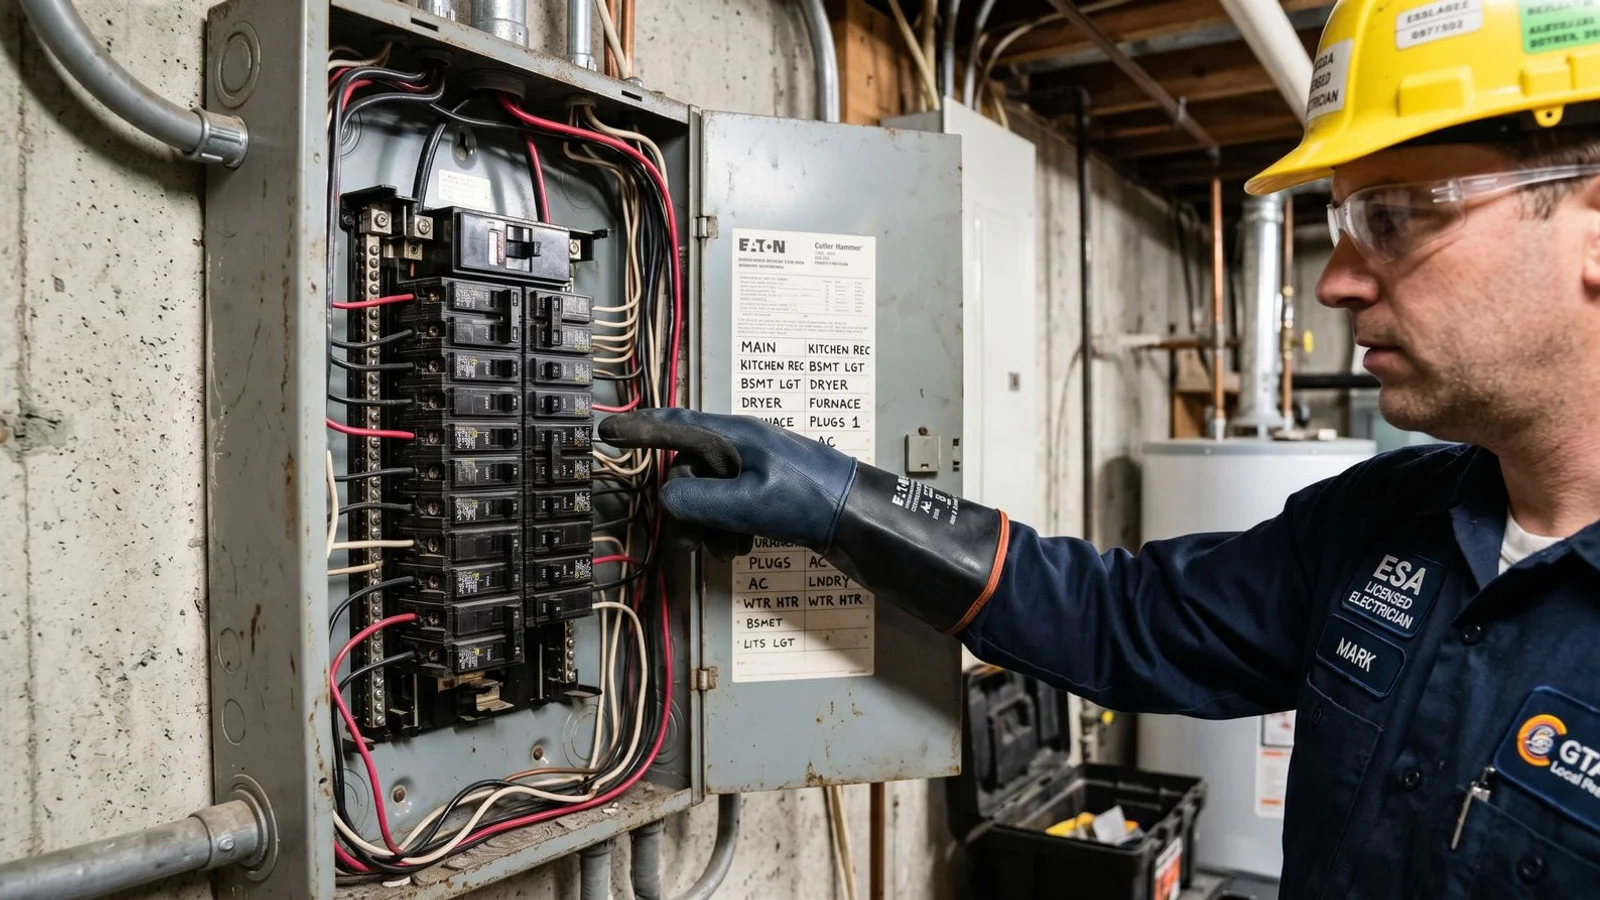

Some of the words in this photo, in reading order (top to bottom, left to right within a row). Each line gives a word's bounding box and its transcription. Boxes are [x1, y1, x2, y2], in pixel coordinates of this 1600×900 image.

[815, 242, 833, 250] Cutler
[836, 243, 861, 251] Hammer
[741, 341, 776, 353] MAIN
[808, 344, 849, 355] KITCHEN
[853, 345, 870, 355] REC
[740, 359, 784, 371] KITCHEN
[788, 360, 805, 371] REC
[809, 361, 839, 372] BSMT
[845, 363, 864, 372] LGT
[741, 378, 774, 389] BSMT
[780, 379, 801, 389] LGT
[810, 379, 848, 390] DRYER
[742, 397, 782, 408] DRYER
[809, 398, 861, 409] FURNACE
[810, 416, 845, 428] PLUGS
[852, 416, 860, 428] 1
[749, 557, 791, 569] PLUGS
[1372, 554, 1426, 596] ESA
[748, 578, 769, 589] AC
[809, 575, 850, 588] LNDRY
[808, 595, 834, 606] WTR
[839, 593, 863, 605] HTR
[1364, 581, 1413, 610] LICENSED
[743, 597, 771, 609] WTR
[776, 596, 799, 607] HTR
[1348, 591, 1413, 629] ELECTRICIAN
[746, 618, 783, 629] BSMET
[744, 639, 766, 649] LITS
[773, 638, 795, 648] LGT
[1336, 637, 1376, 672] MARK
[1549, 760, 1584, 786] Local
